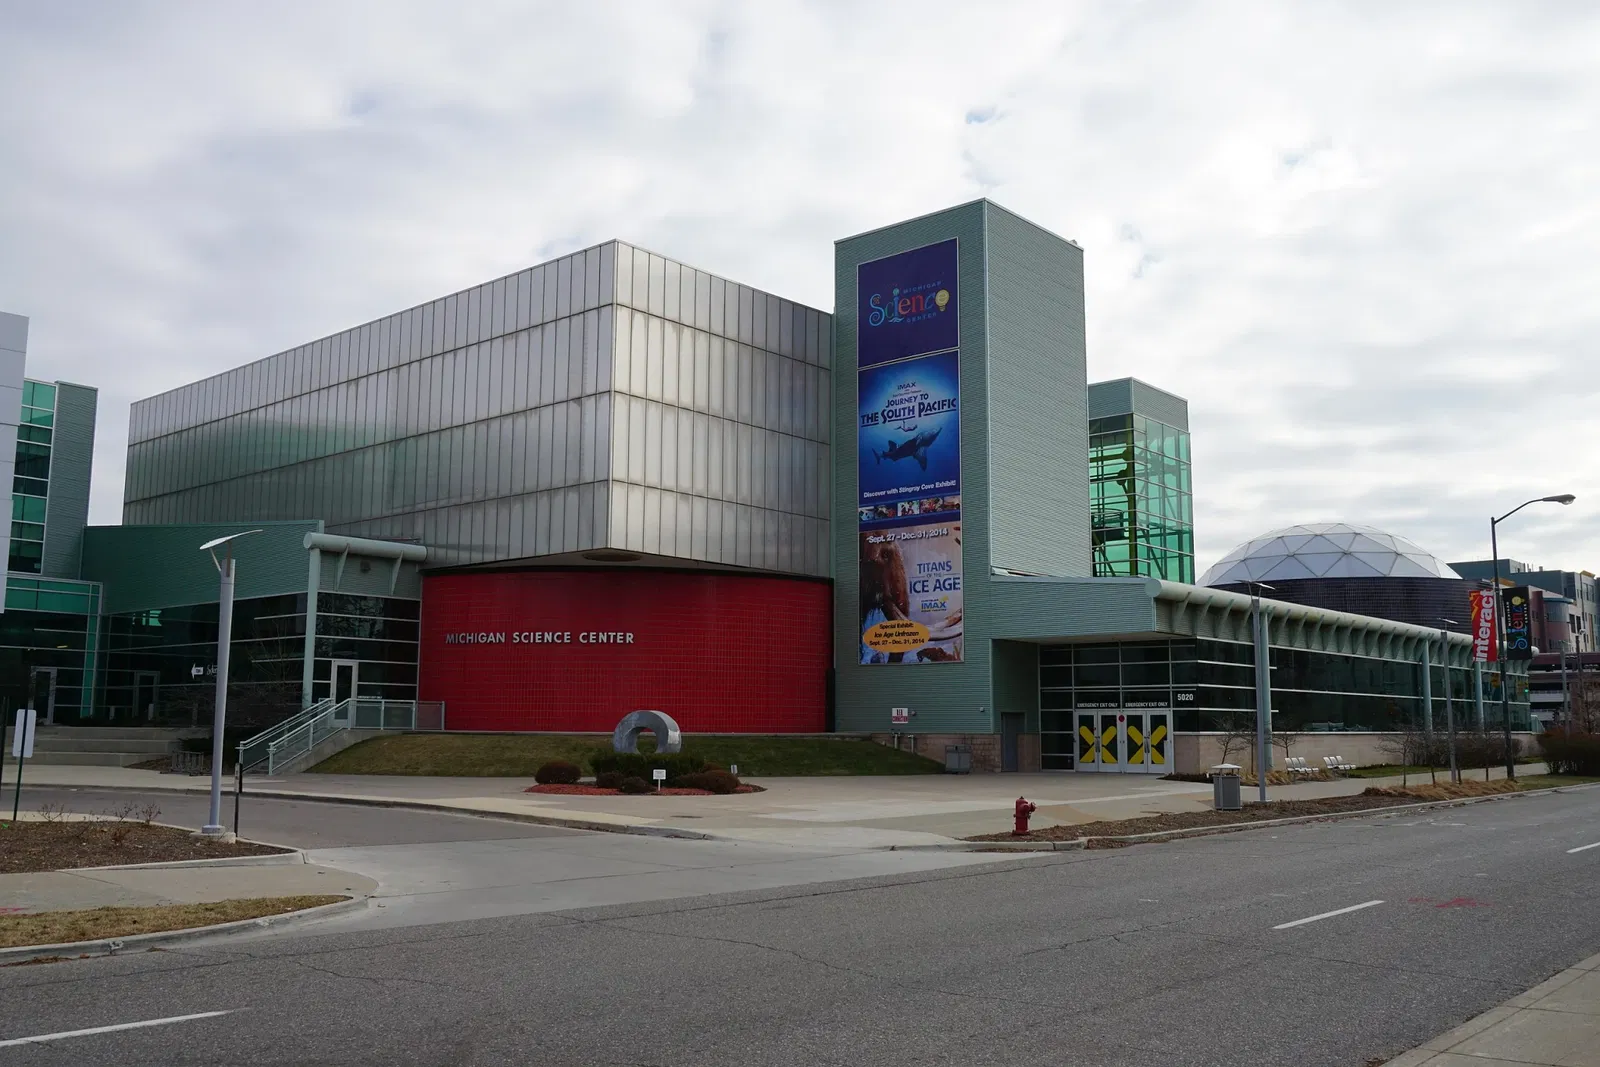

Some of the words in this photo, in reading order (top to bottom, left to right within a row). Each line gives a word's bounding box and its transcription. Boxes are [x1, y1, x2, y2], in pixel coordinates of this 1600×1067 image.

[869, 289, 950, 327] Science
[897, 382, 916, 390] IMAX
[886, 395, 918, 408] JOURNEY
[920, 393, 929, 401] TO
[861, 412, 879, 425] THE
[881, 405, 915, 424] SOUTH
[918, 398, 957, 417] PACIFIC
[863, 490, 886, 498] Discover
[930, 527, 948, 536] 2014
[917, 561, 952, 574] TITANS
[909, 580, 929, 594] ICE
[933, 578, 961, 592] AGE
[445, 632, 506, 644] MICHIGAN
[512, 631, 571, 643] SCIENCE
[579, 632, 634, 644] CENTER
[883, 631, 893, 639] Age
[1177, 693, 1194, 701] 5020
